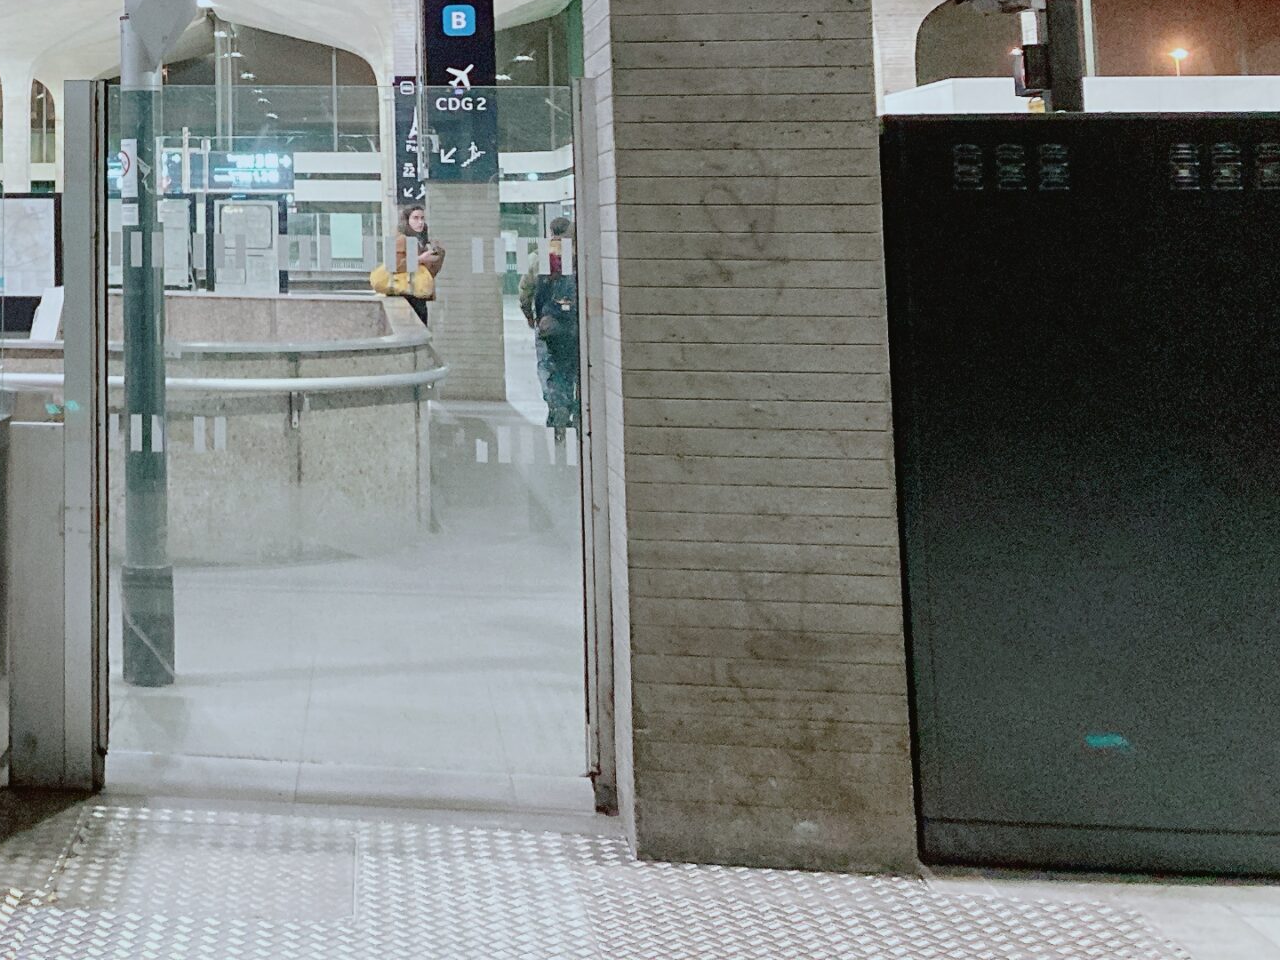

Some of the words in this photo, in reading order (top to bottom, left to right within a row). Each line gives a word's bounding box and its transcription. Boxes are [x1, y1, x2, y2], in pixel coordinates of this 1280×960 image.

[451, 11, 467, 29] B
[435, 97, 473, 111] CDG
[476, 97, 487, 111] 2
